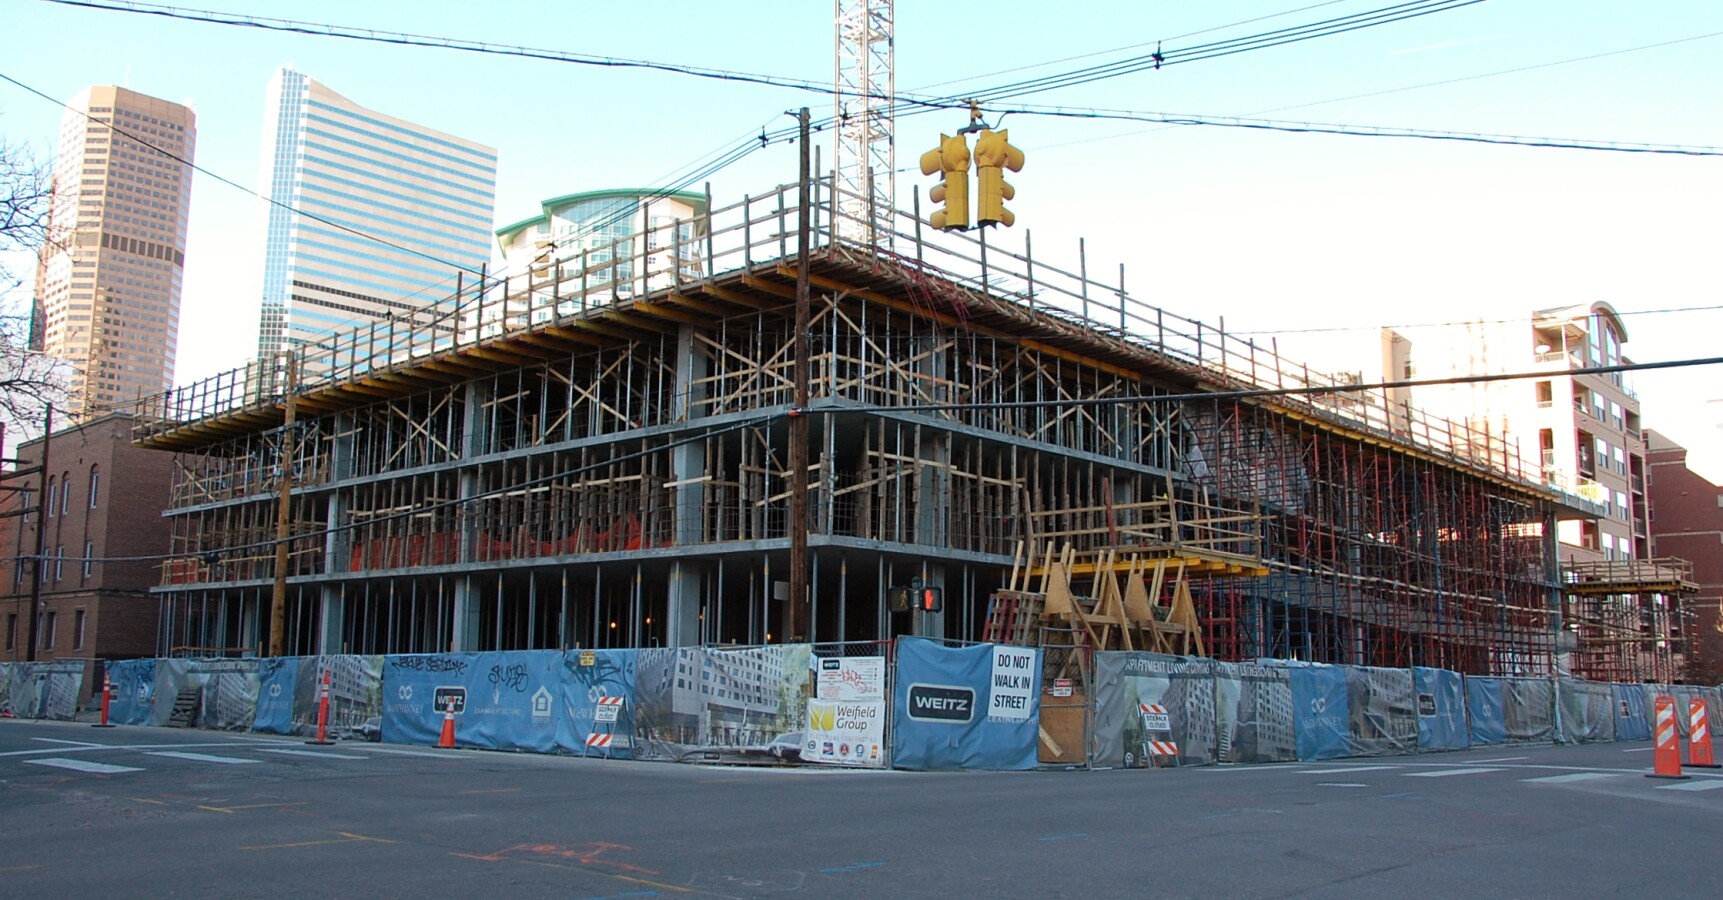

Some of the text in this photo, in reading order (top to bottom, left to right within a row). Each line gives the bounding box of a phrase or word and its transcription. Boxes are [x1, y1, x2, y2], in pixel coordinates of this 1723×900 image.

[998, 654, 1031, 669] DO NOT
[994, 674, 1031, 690] WALK IN
[437, 695, 463, 705] WETZ
[915, 695, 967, 711] WEITZ
[994, 694, 1027, 709] STREET
[837, 705, 877, 719] Weifield
[836, 718, 868, 732] Group
